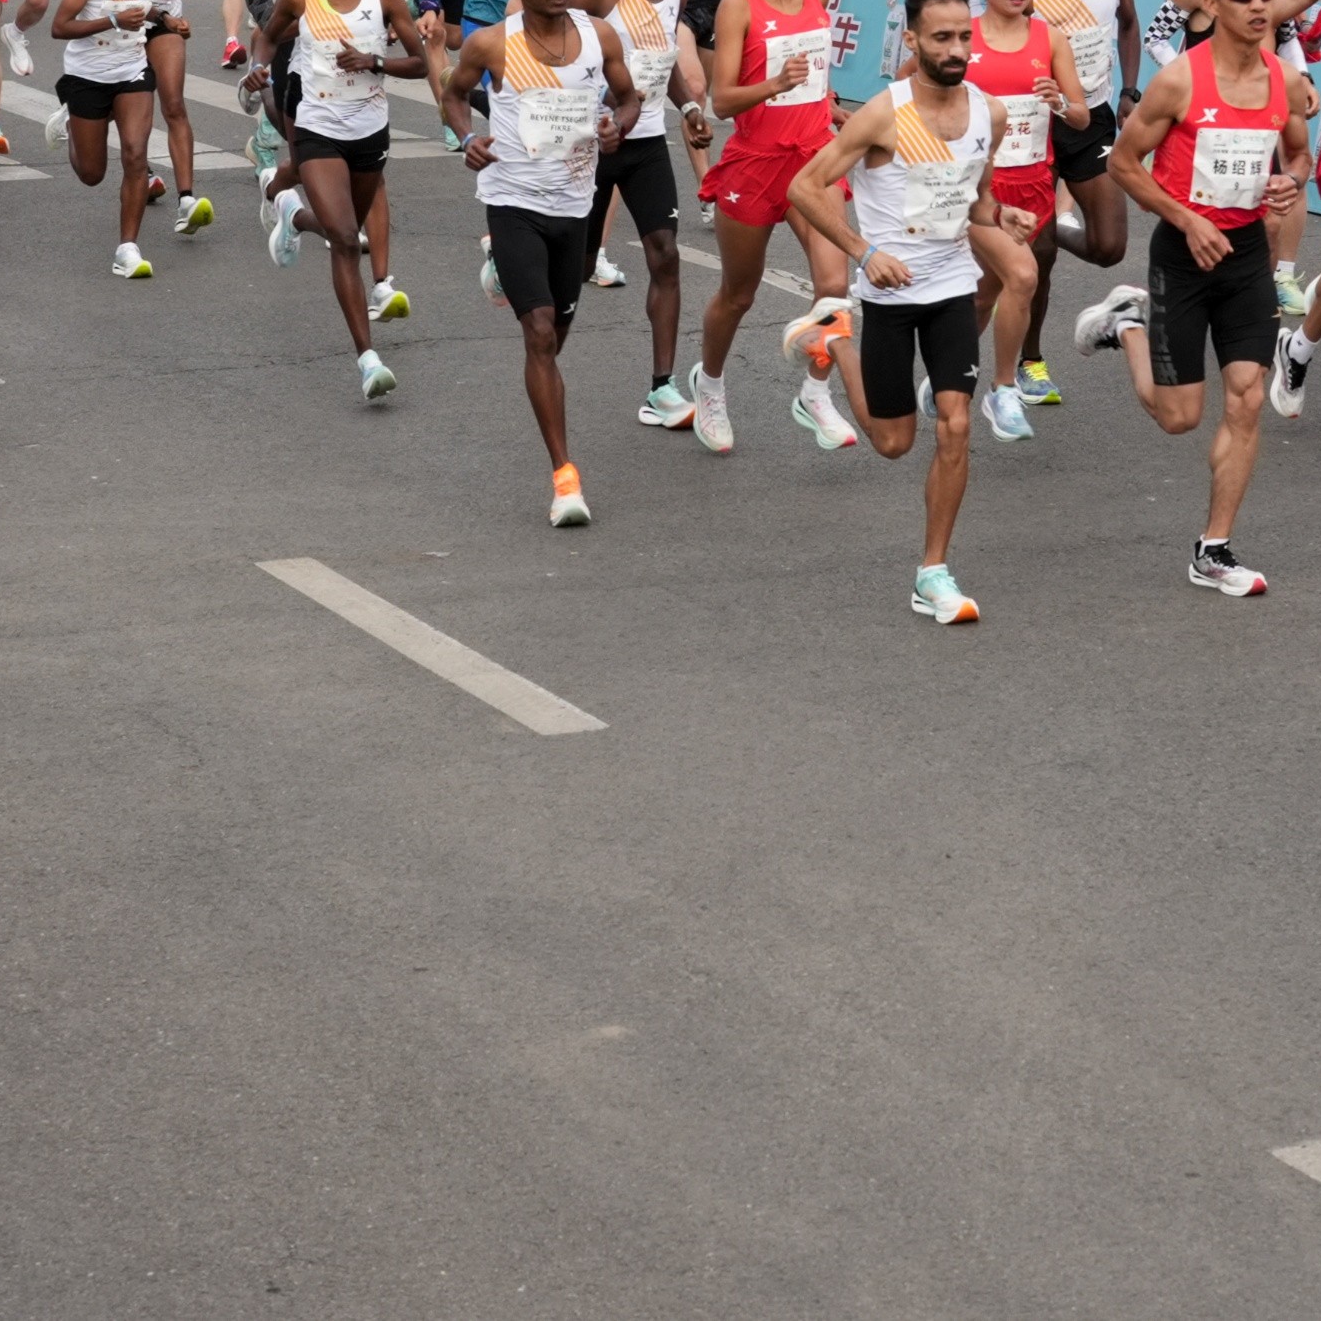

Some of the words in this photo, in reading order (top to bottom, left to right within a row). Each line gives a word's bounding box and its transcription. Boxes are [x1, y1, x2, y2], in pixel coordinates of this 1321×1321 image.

[529, 113, 559, 123] BEYENE
[550, 124, 572, 133] FIKRE
[554, 135, 563, 144] 20
[1212, 158, 1262, 176] 杨绍辉
